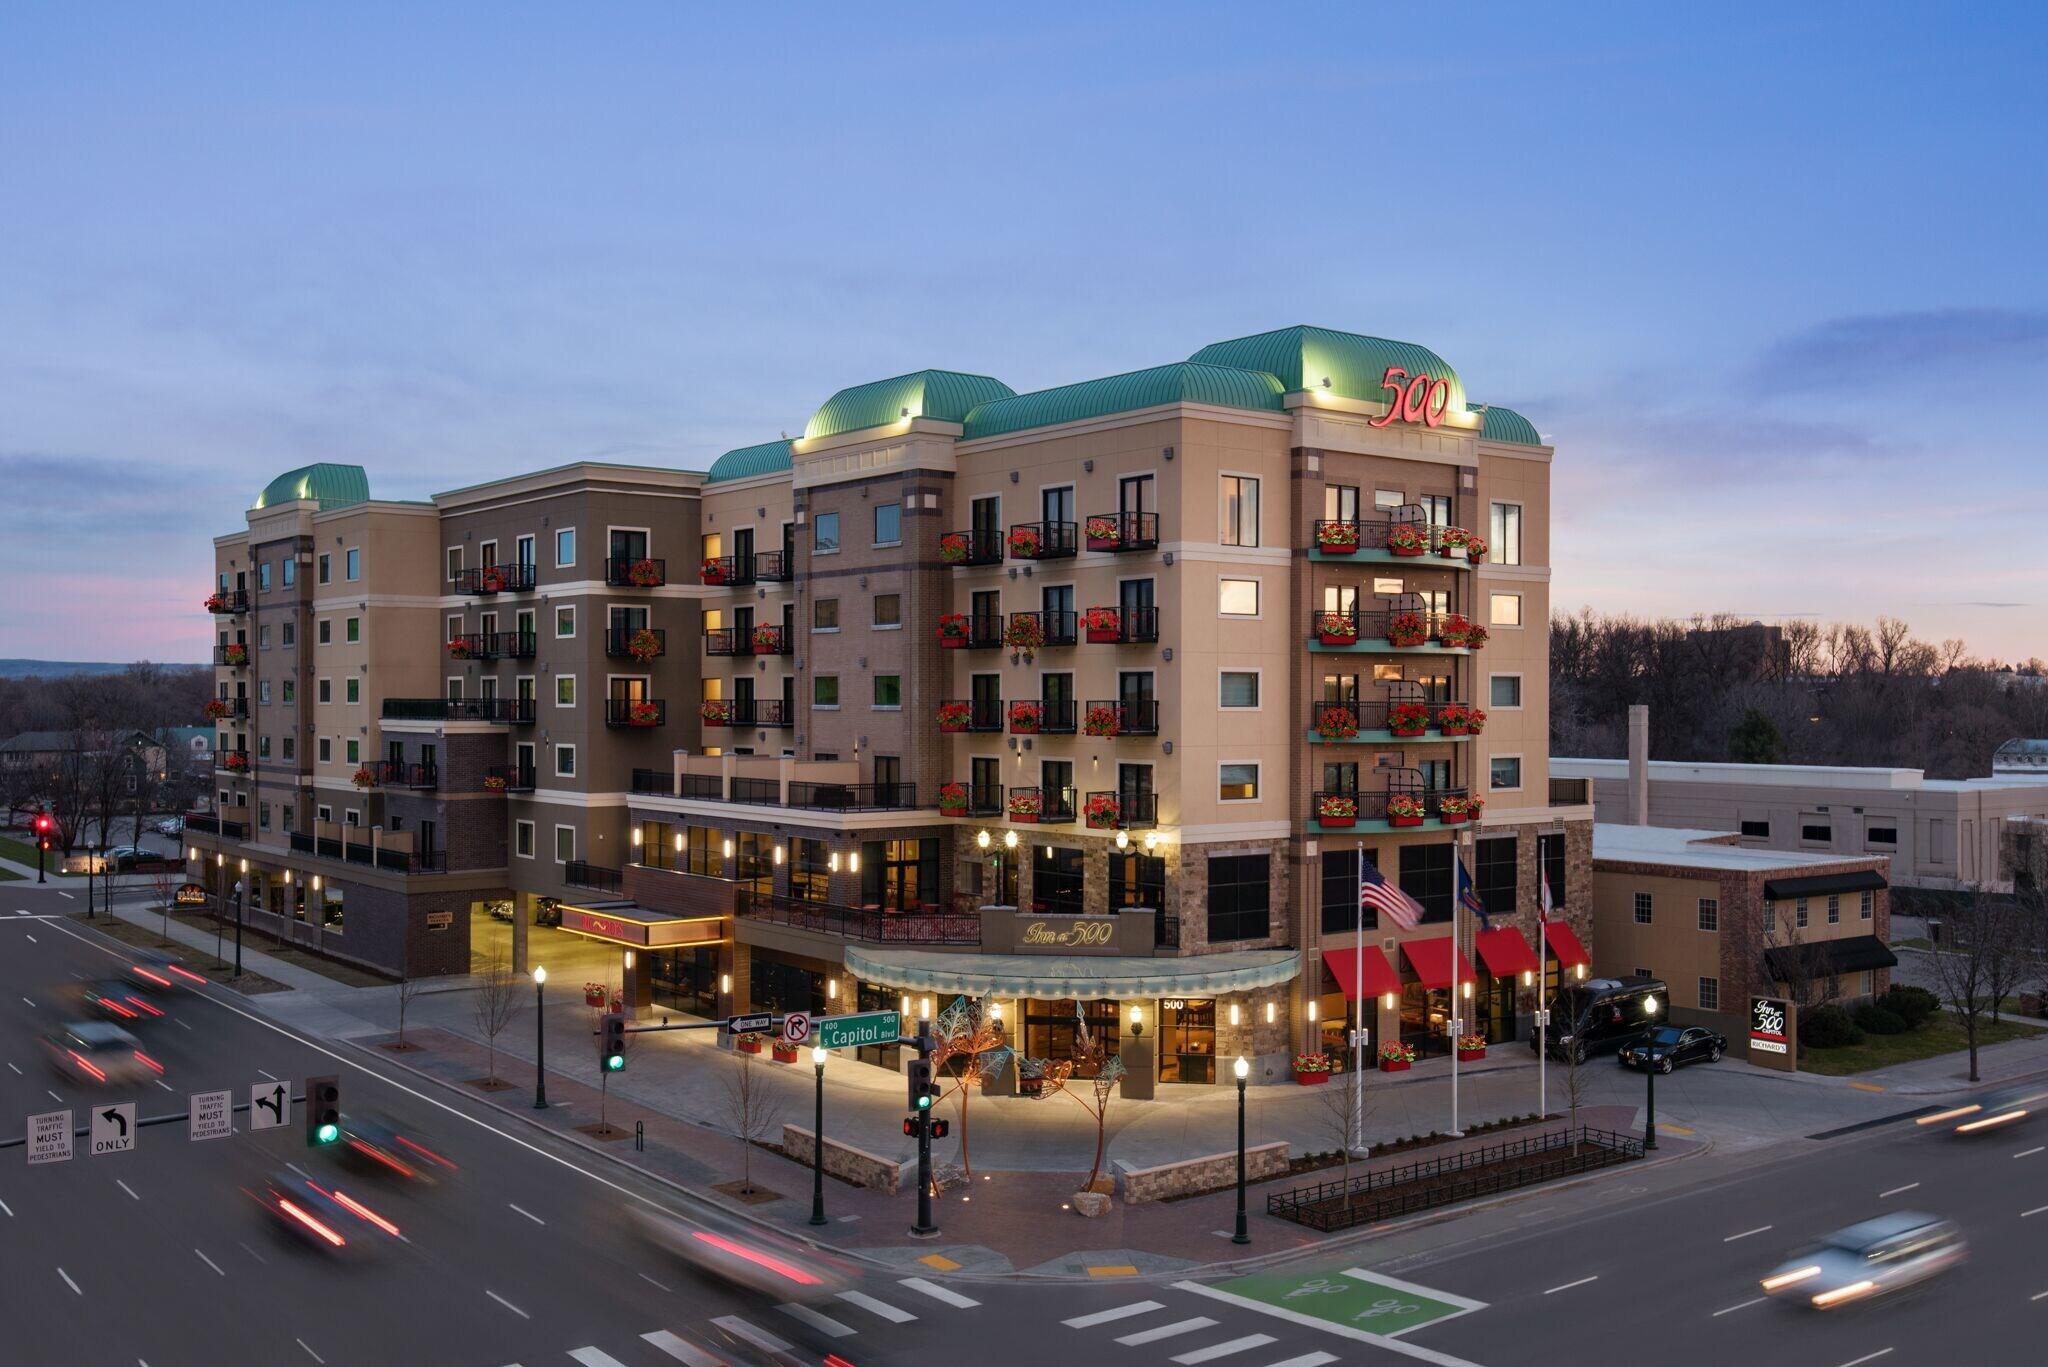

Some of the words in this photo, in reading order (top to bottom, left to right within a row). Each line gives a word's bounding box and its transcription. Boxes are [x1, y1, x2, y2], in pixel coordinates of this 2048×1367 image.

[1368, 367, 1451, 428] 500
[1023, 922, 1056, 944] Inn
[1064, 921, 1113, 947] 500
[1163, 999, 1184, 1010] 500
[1753, 1000, 1775, 1016] Inn
[740, 1020, 752, 1029] ONE
[755, 1018, 768, 1027] WAY
[824, 1021, 838, 1030] 400
[882, 1015, 896, 1024] 500
[1753, 1014, 1784, 1031] 500
[832, 1026, 878, 1047] Capitol
[880, 1029, 895, 1039] Blvd
[1752, 1040, 1786, 1052] RICHARD'S
[198, 1094, 225, 1103] TURNING
[200, 1102, 224, 1110] TRAFFIC
[35, 1114, 64, 1125] TURNING
[199, 1110, 224, 1121] MUST
[37, 1123, 63, 1132] TRAFFIC
[198, 1121, 215, 1130] YIELD
[36, 1132, 63, 1144] MUST
[192, 1127, 230, 1138] PEDESTRIANS
[35, 1144, 54, 1153] YIELD
[57, 1142, 65, 1150] TO
[96, 1138, 130, 1152] ONLY
[29, 1150, 71, 1161] PEDESTRIANS
